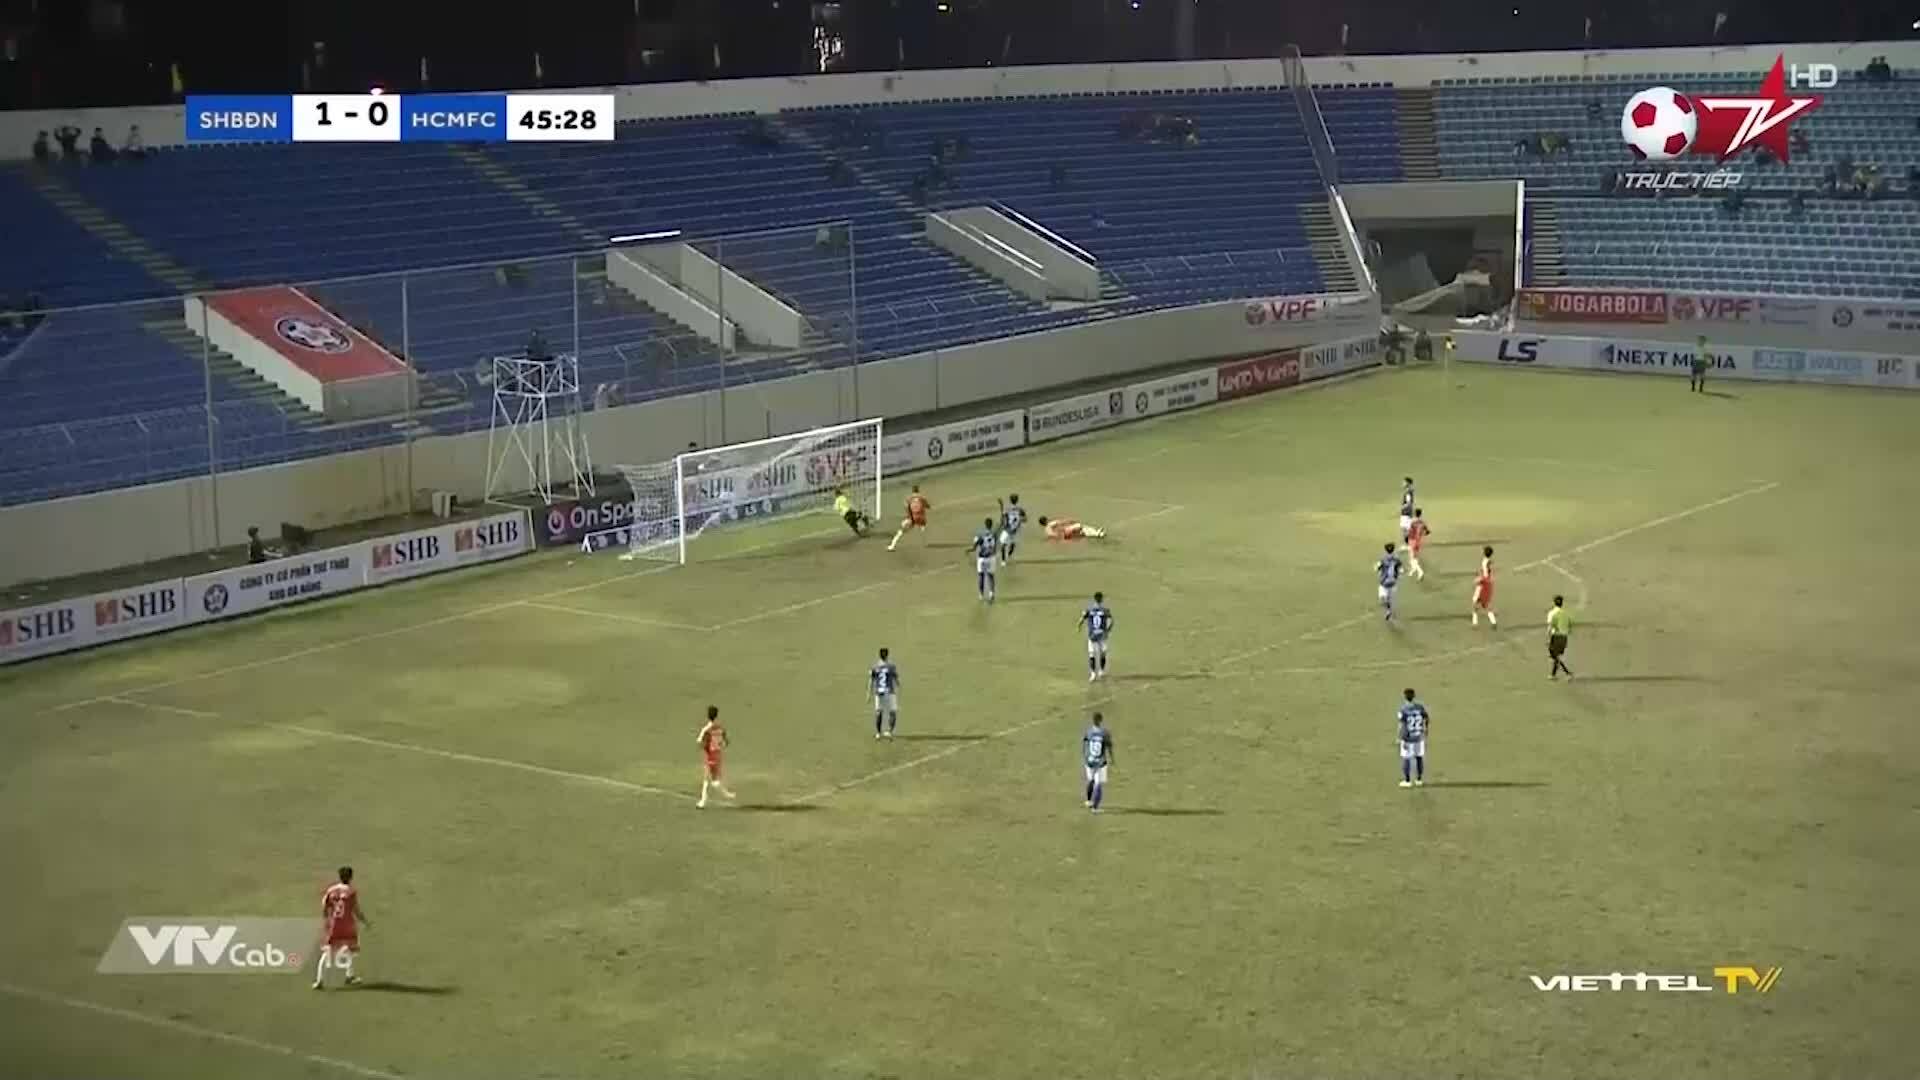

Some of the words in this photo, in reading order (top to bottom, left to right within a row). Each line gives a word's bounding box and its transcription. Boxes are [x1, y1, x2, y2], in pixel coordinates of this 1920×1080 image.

[1270, 298, 1317, 321] VPF
[1548, 293, 1665, 314] JOGARBOLA
[1701, 297, 1752, 321] VPF
[1498, 338, 1539, 363] LS
[1617, 348, 1668, 366] NEXT
[570, 506, 599, 529] On
[476, 519, 518, 548] SHB
[394, 535, 439, 565] SHB
[121, 588, 176, 622] SHB
[17, 608, 75, 643] SHB
[1407, 715, 1423, 731] 22
